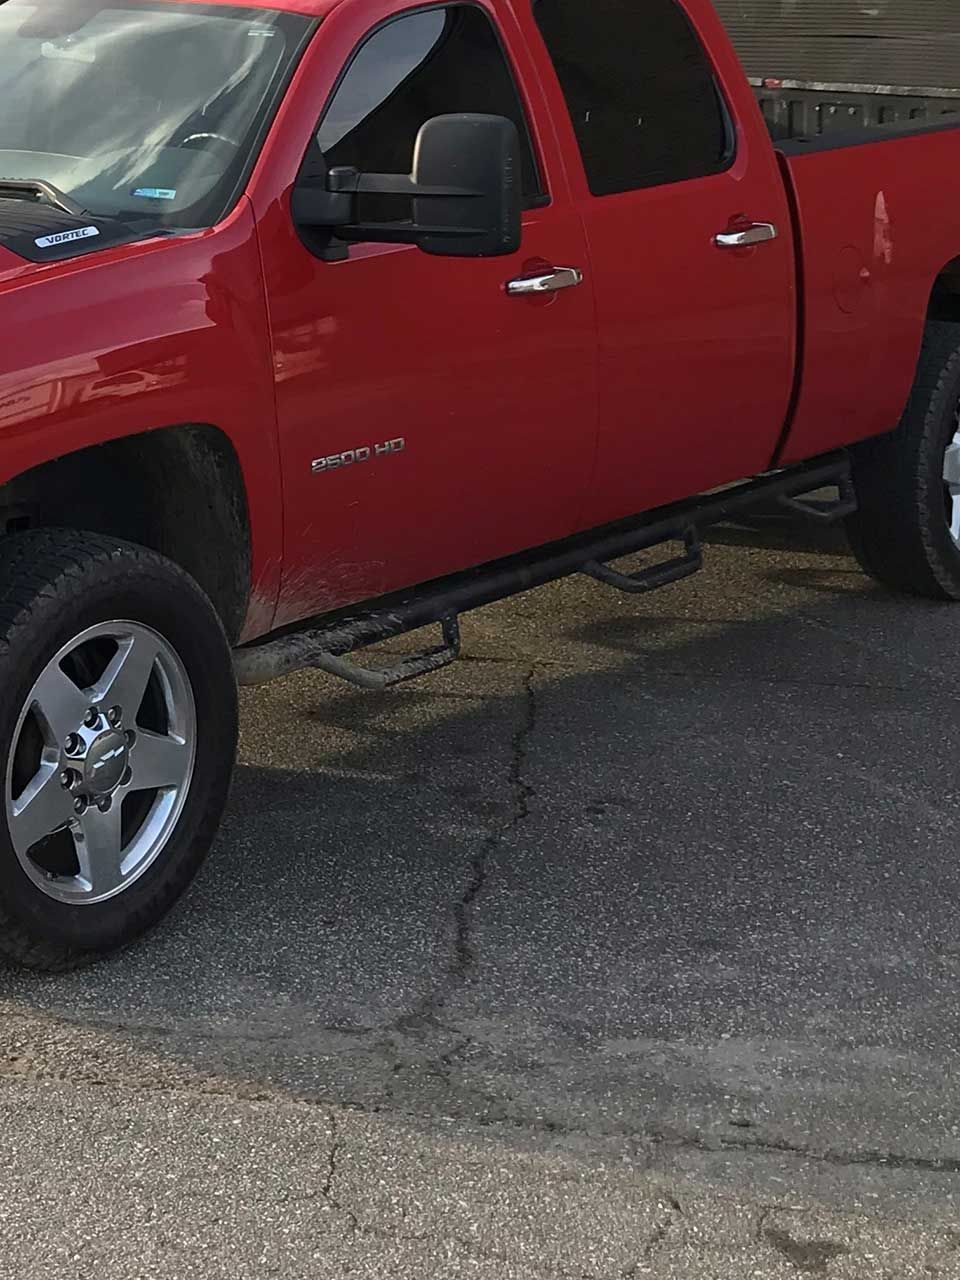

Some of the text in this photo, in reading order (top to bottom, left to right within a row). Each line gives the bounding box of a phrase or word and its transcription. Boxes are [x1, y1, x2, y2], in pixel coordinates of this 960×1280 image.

[45, 228, 90, 244] VORTEC
[311, 437, 406, 473] 2500 HD
